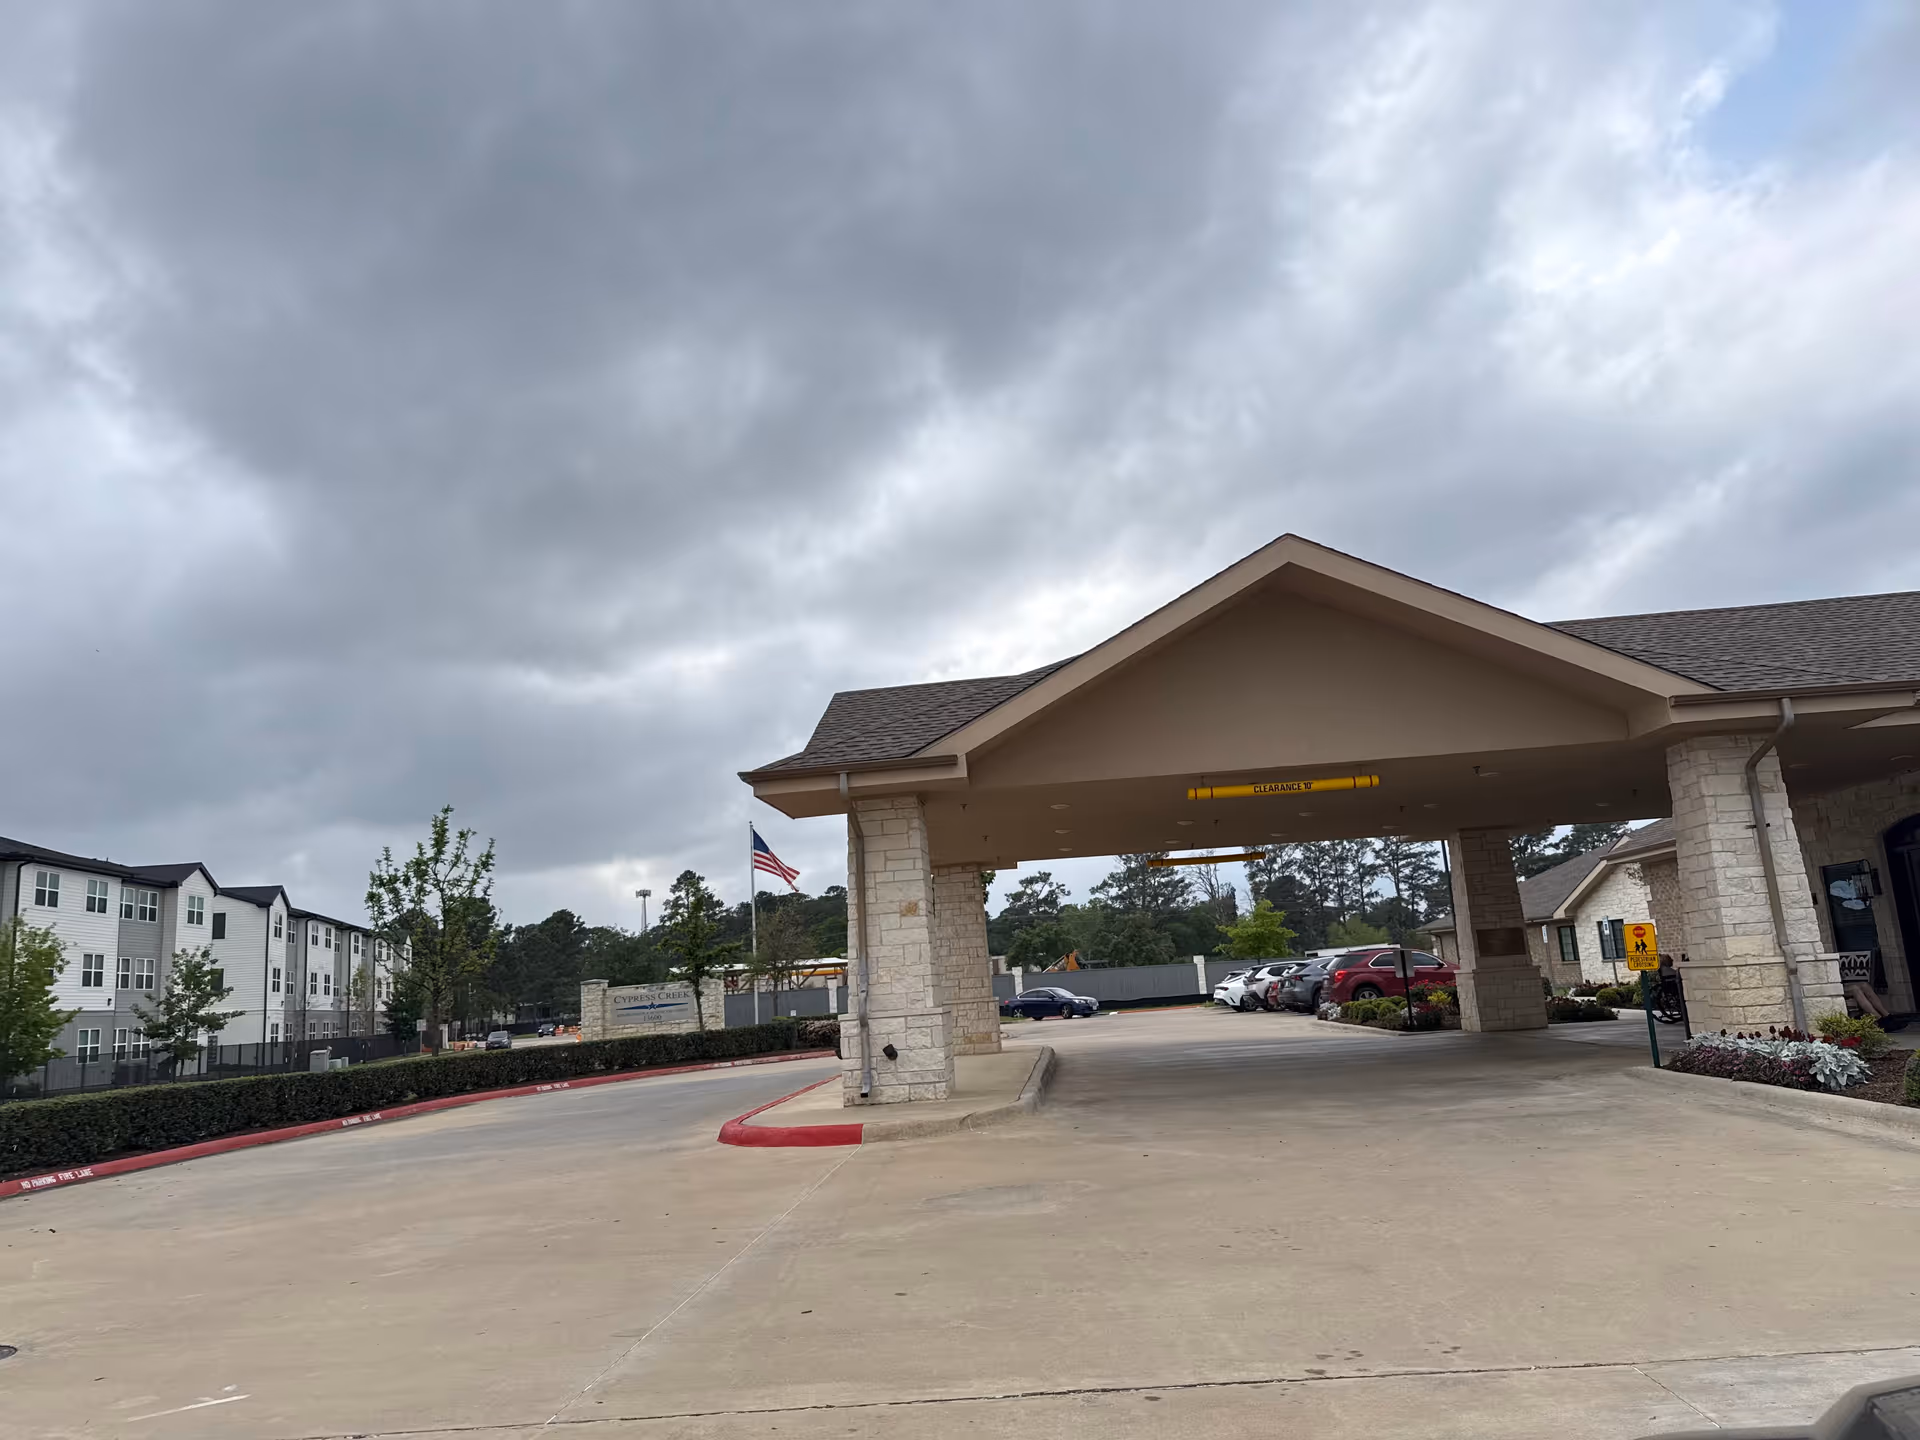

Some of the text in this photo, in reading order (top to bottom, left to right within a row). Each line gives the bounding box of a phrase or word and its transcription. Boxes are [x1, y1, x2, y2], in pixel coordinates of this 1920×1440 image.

[1253, 782, 1302, 793] CLEARANCE
[613, 990, 691, 1004] CYPRESS CREEK
[20, 1168, 94, 1190] NO PARKING FIRE LANE
